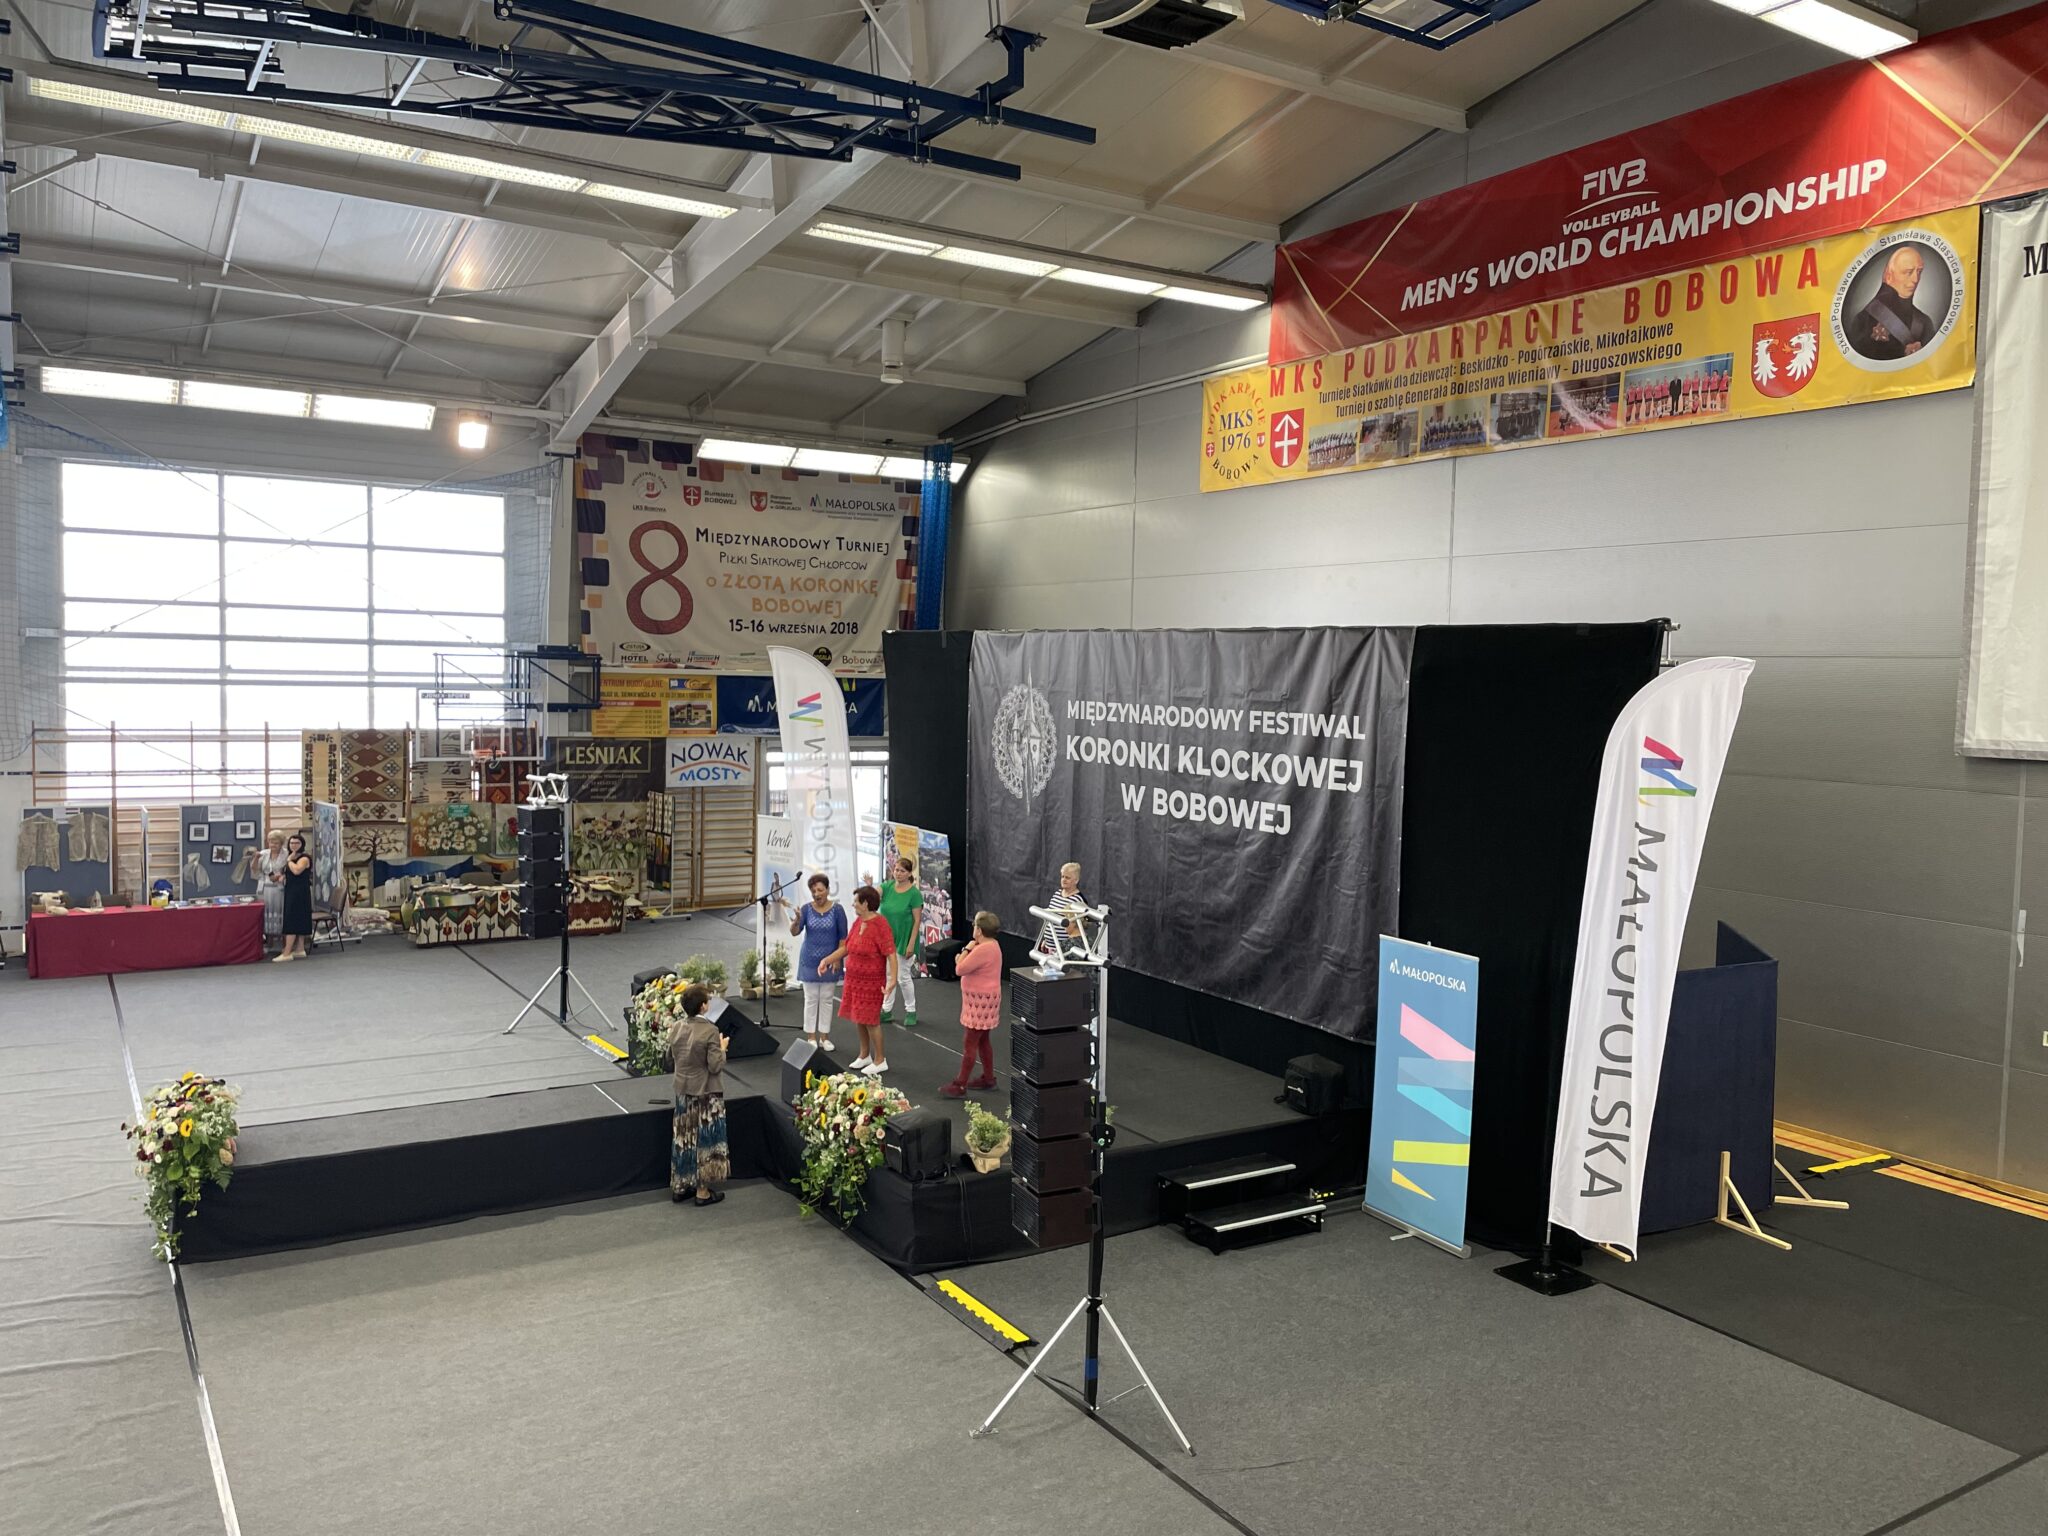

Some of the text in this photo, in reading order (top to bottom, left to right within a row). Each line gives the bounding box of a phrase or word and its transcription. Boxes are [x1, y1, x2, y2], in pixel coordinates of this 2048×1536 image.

[1582, 158, 1647, 200] FIVB
[1562, 201, 1661, 235] VOLLEYBALL
[1401, 158, 1888, 312] MEN'S WORLD CHAMPIONSHIP
[1879, 230, 1932, 247] Stanisława
[1933, 237, 1960, 274] Staszica
[1832, 259, 1863, 322] Podstawowa
[1954, 277, 1962, 285] w
[1270, 247, 1820, 398] MKS PODKARPACIE BOBOWA
[1939, 289, 1963, 335] Bobowej
[1833, 324, 1850, 355] Szkoła
[1319, 384, 1351, 405] Turnieje
[1352, 376, 1392, 398] Siatkówki
[1393, 374, 1408, 388] dla
[1409, 365, 1457, 386] dziewcząt:
[1460, 353, 1509, 376] Beskidzko
[1518, 336, 1594, 365] Pogórzańskie,
[1596, 322, 1674, 350] Mikołajkowe
[1336, 401, 1367, 418] Turniej
[1367, 403, 1373, 412] o
[1374, 396, 1403, 411] szablę
[1405, 385, 1449, 405] Generała
[1450, 374, 1505, 396] Bolesława
[1508, 364, 1561, 386] Wieniawy
[1572, 342, 1683, 375] Długoszowskiego
[1207, 382, 1266, 436] PODKARPACIE
[1219, 408, 1253, 431] MKS
[1221, 431, 1251, 453] 1976
[1212, 454, 1259, 480] BOBOWA
[825, 498, 896, 512] MAŁOPOLSKA
[626, 520, 693, 635] 8
[723, 573, 786, 594] ZŁOTĄ
[790, 577, 879, 597] KORONKĘ
[752, 597, 842, 619] BOBOWEJ
[729, 618, 765, 633] 15-16
[830, 621, 859, 635] 2018
[621, 655, 648, 663] HOTEL
[1067, 700, 1366, 740] MIĘDZYNARODOWY FESTIWAL
[565, 743, 642, 765] LEŚNIAK
[671, 742, 749, 768] NOWAK
[1066, 734, 1364, 793] KORONKI KLOCKOWEJ
[679, 767, 741, 782] MOSTY
[1120, 782, 1291, 835] W BOBOWEJ
[1402, 964, 1467, 993] MAŁOPOLSKA
[1579, 821, 1667, 1200] MAŁOPOLSKA
